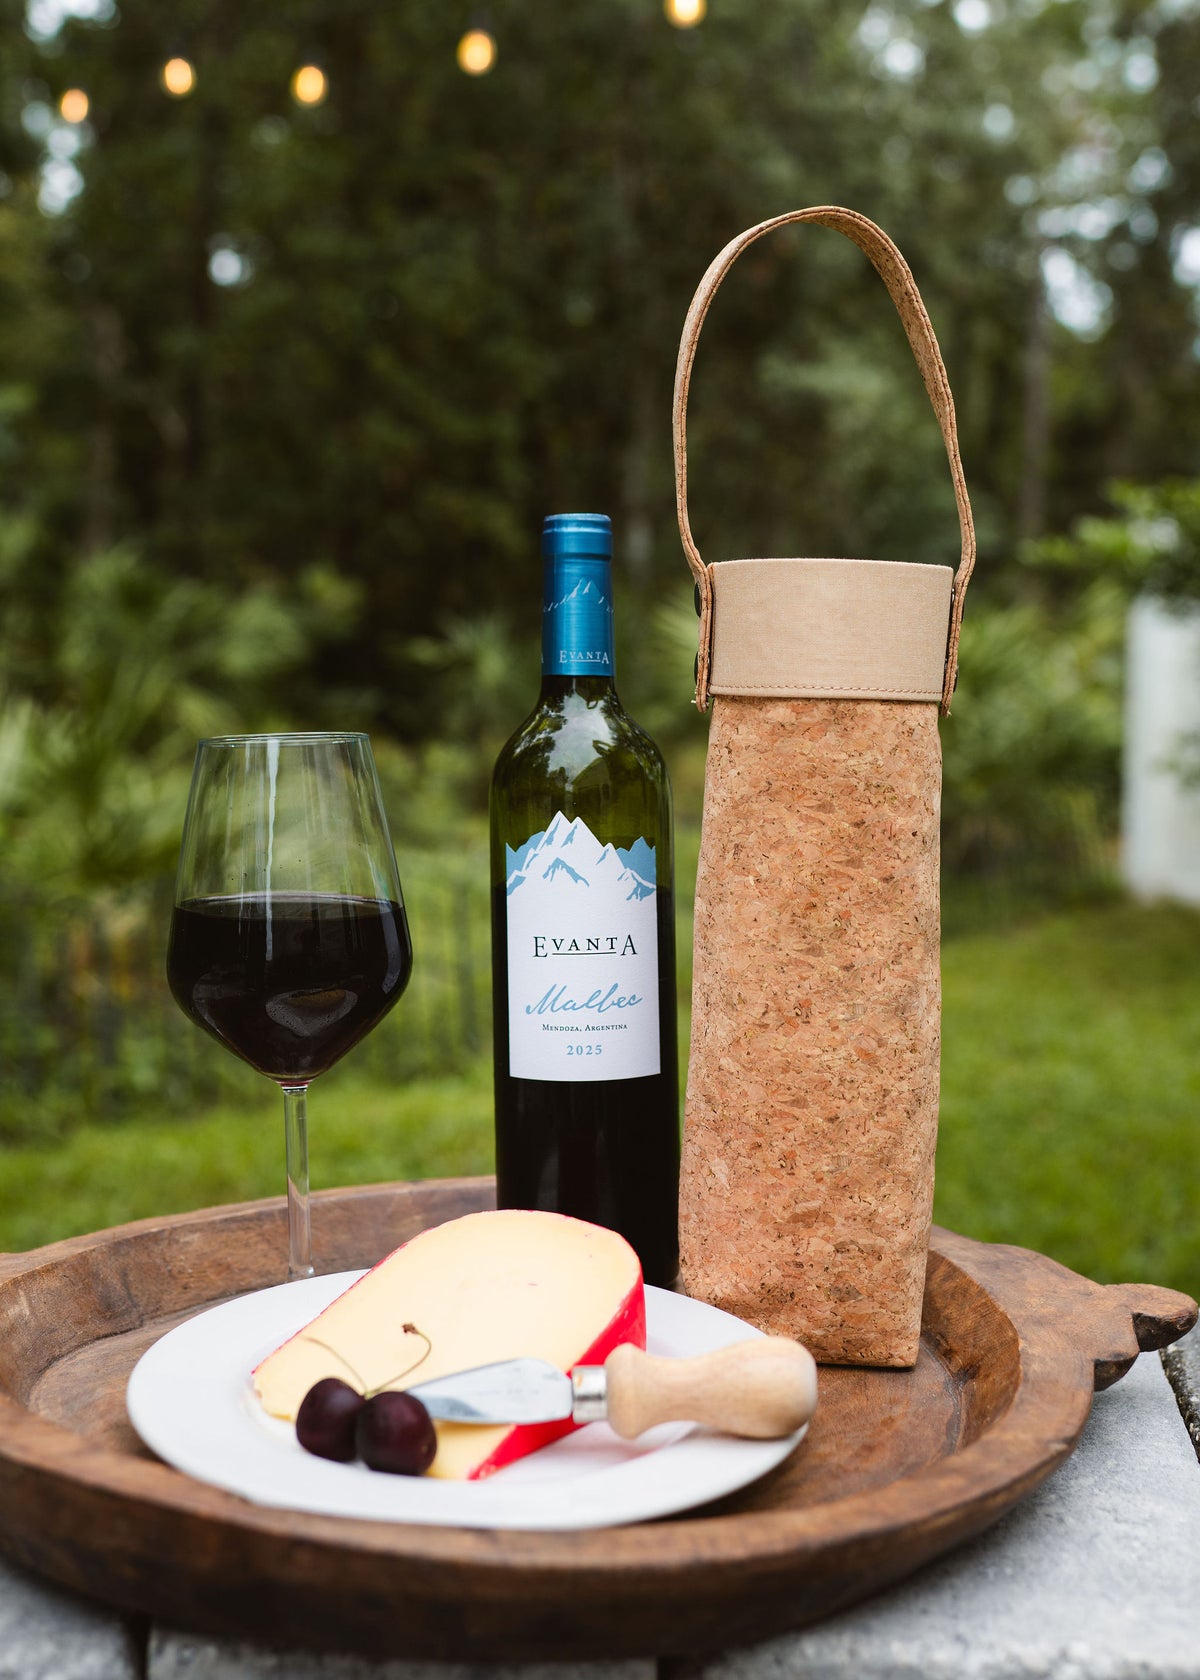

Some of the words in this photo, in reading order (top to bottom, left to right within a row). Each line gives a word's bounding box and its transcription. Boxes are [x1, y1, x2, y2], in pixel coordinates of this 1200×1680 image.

[559, 650, 610, 664] EVANTA
[533, 933, 638, 957] EVANTA
[525, 982, 643, 1015] Malbec
[542, 1023, 582, 1032] MENDOZA,
[584, 1023, 628, 1032] ARGENTINA
[566, 1044, 603, 1056] 2025
